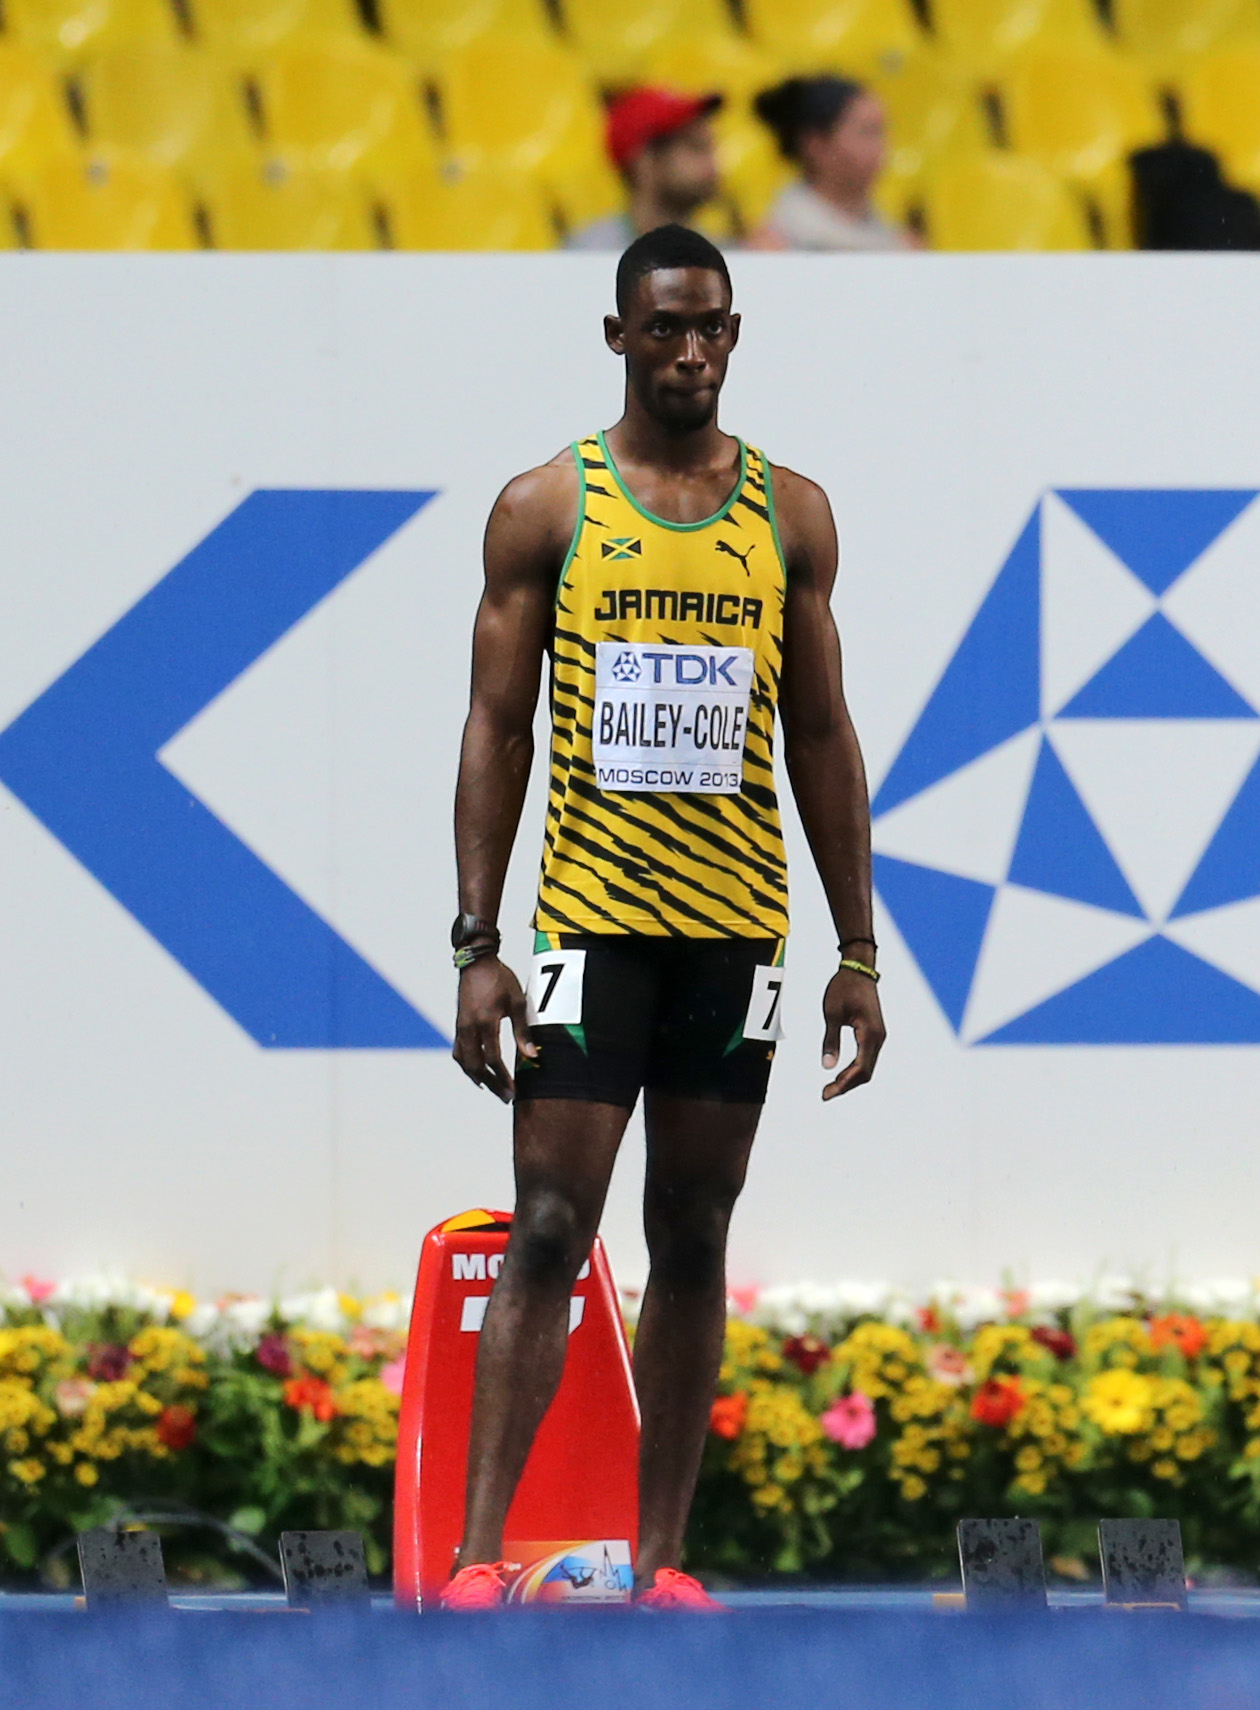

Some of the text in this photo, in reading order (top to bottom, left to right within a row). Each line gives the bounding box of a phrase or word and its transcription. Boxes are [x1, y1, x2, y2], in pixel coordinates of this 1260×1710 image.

[594, 589, 763, 629] JAMAICA
[643, 653, 737, 686] TDK
[599, 701, 744, 751] BAILEY-COLE
[598, 768, 739, 787] MOSCOW 2013
[538, 964, 565, 1013] 7
[762, 981, 781, 1030] 7
